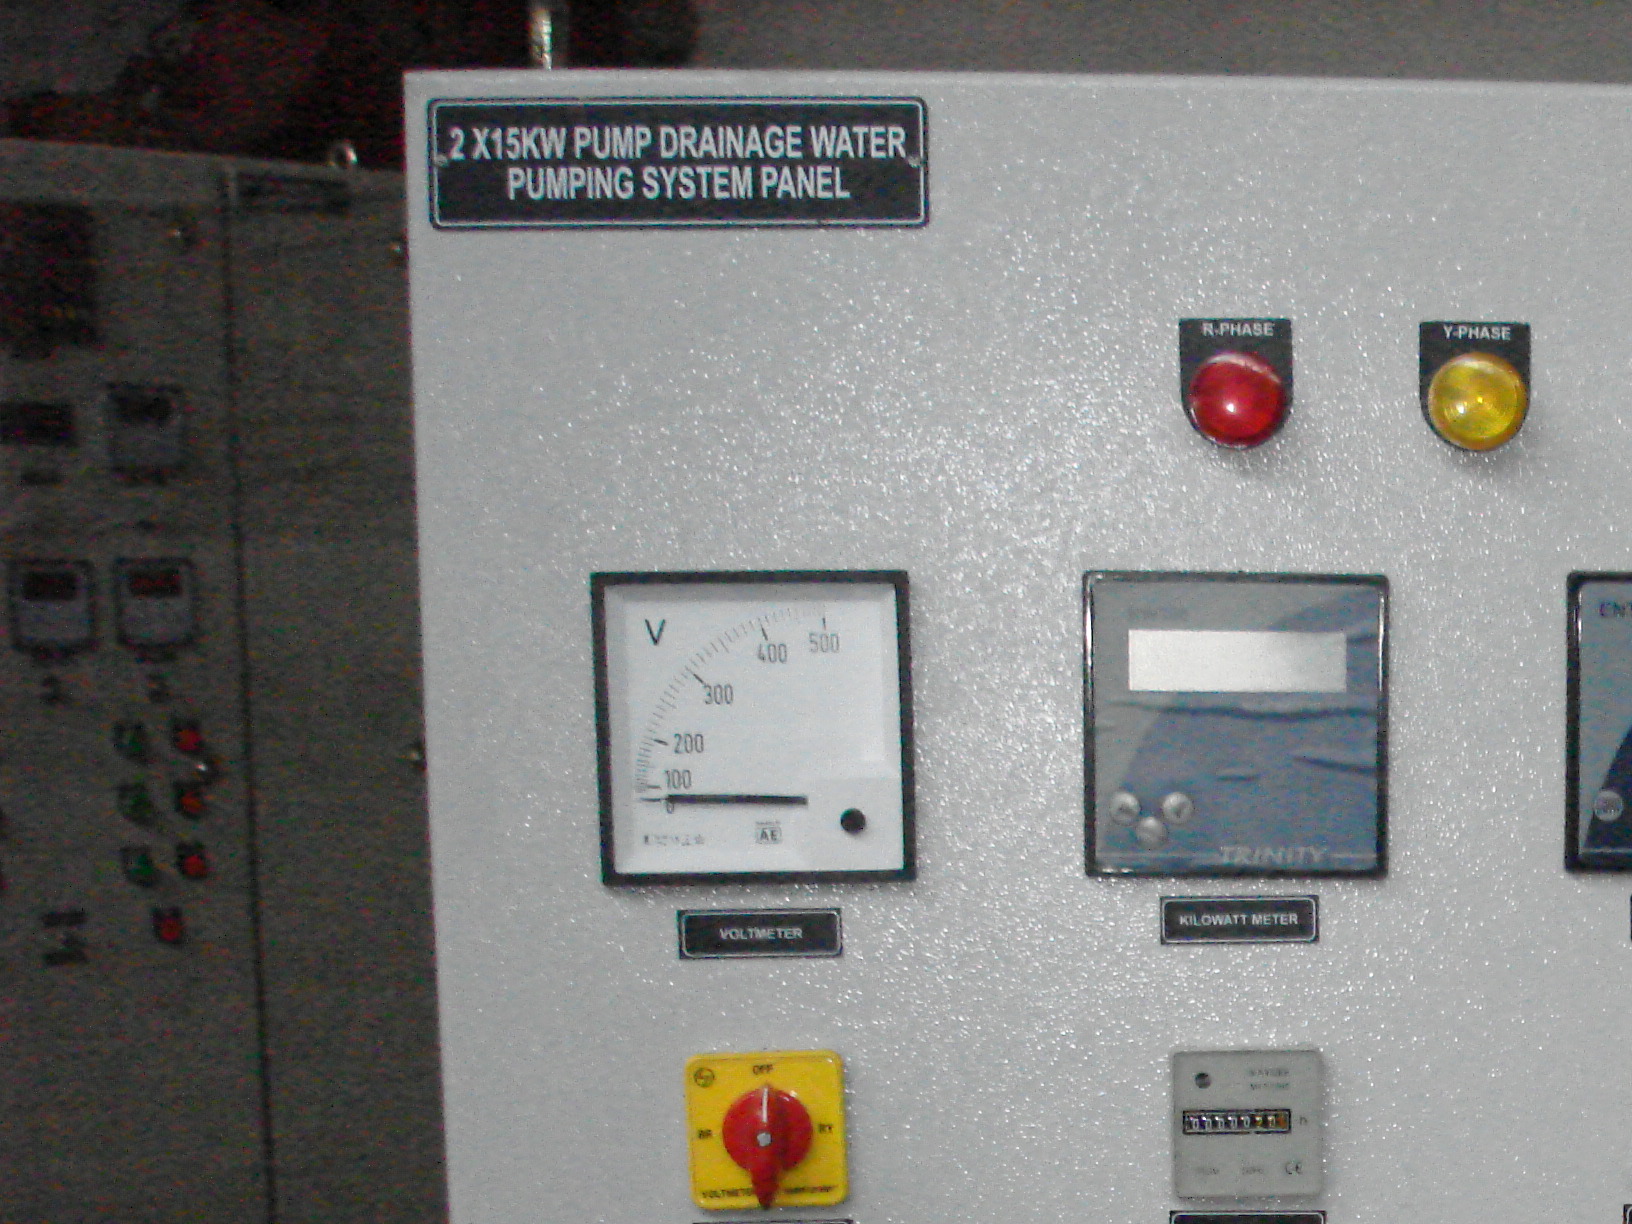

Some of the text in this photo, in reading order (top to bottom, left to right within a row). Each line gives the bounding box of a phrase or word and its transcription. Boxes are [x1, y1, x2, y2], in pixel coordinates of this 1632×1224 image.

[448, 124, 907, 161] 2 X15KW PUMP DRAINAGE WATER
[508, 165, 850, 201] PUMPING SYSTEM PANEL
[1202, 322, 1276, 337] R-PHASE
[1443, 326, 1511, 341] Y-PHASE
[645, 618, 666, 646] V
[809, 632, 840, 654] 500
[756, 643, 788, 665] 400
[704, 684, 734, 705] 300
[673, 733, 705, 754] 200
[664, 769, 692, 790] 100
[1179, 913, 1298, 926] KILOWATT METER
[719, 927, 803, 940] VOLTMETER
